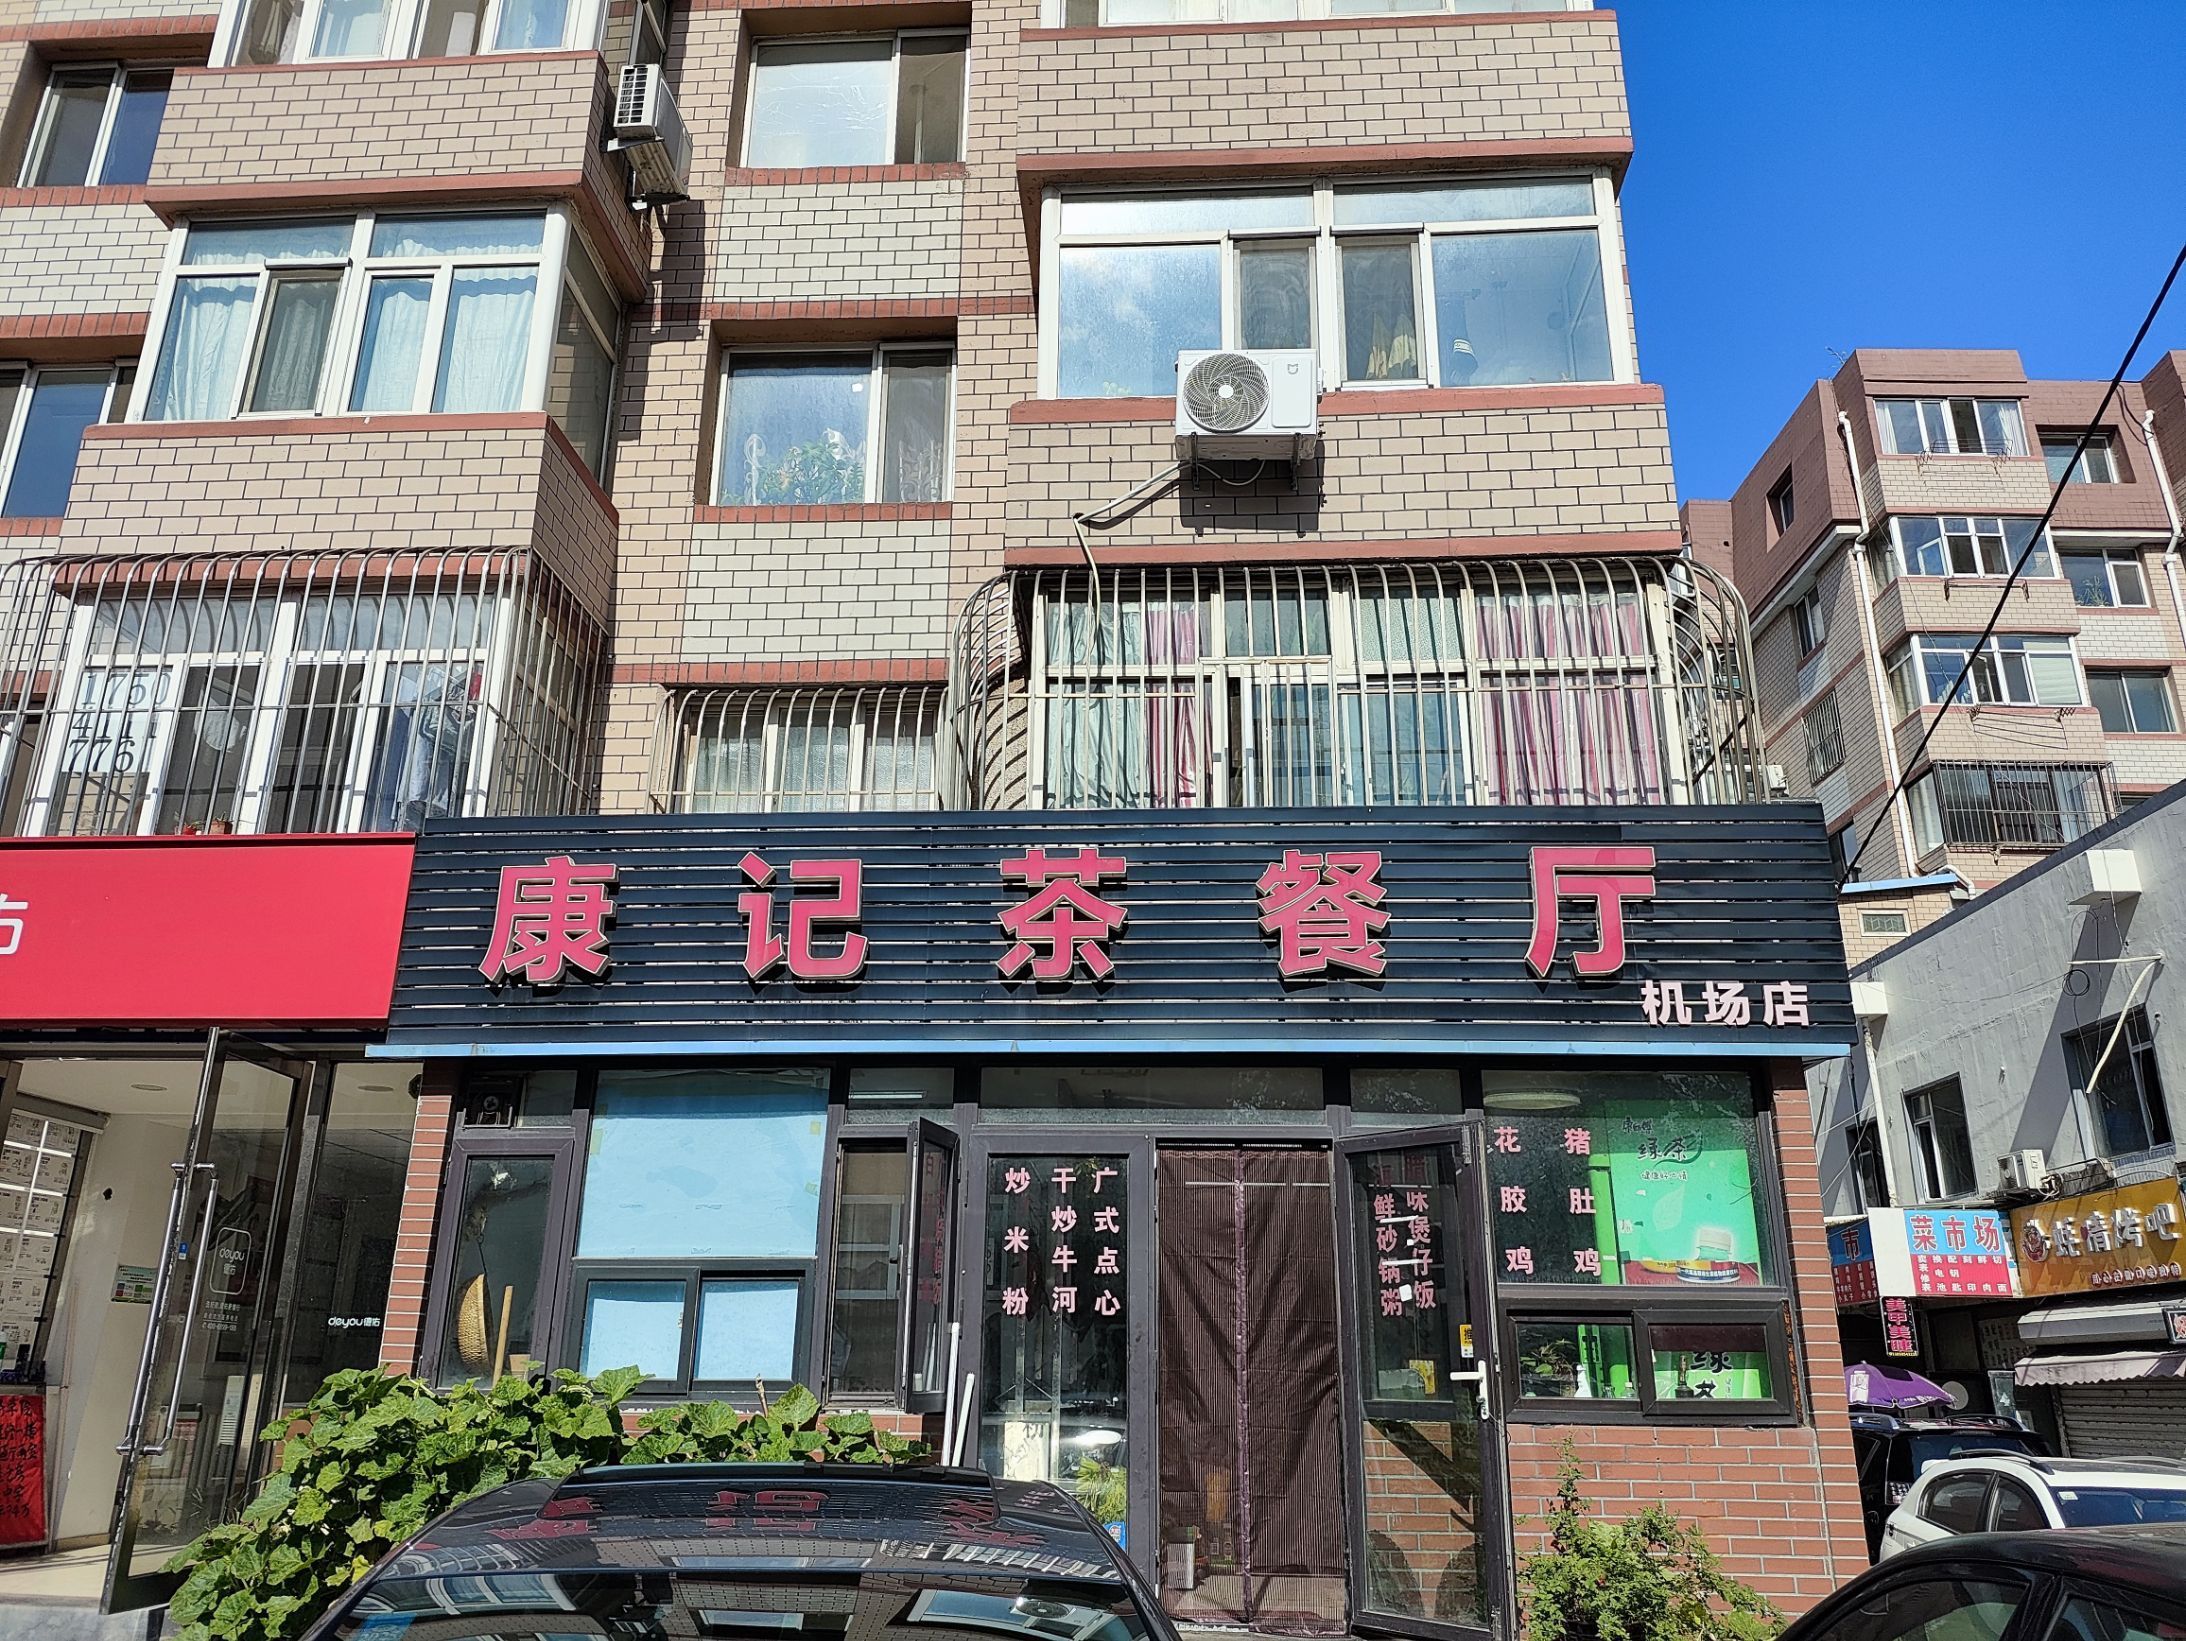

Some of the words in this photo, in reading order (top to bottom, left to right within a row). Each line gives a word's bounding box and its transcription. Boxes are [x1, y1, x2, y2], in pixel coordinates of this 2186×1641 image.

[478, 846, 1656, 984] 康记茶餐厅
[1640, 980, 1811, 1028] 机场店
[1002, 1167, 1030, 1316] 炒米粉
[1051, 1168, 1077, 1315] 干炒牛河
[1093, 1167, 1121, 1317] 广式点心
[1494, 1127, 1534, 1276] 花胶鸡
[1564, 1127, 1601, 1277] 猪肚鸡
[1910, 1214, 2001, 1253] 菜市场
